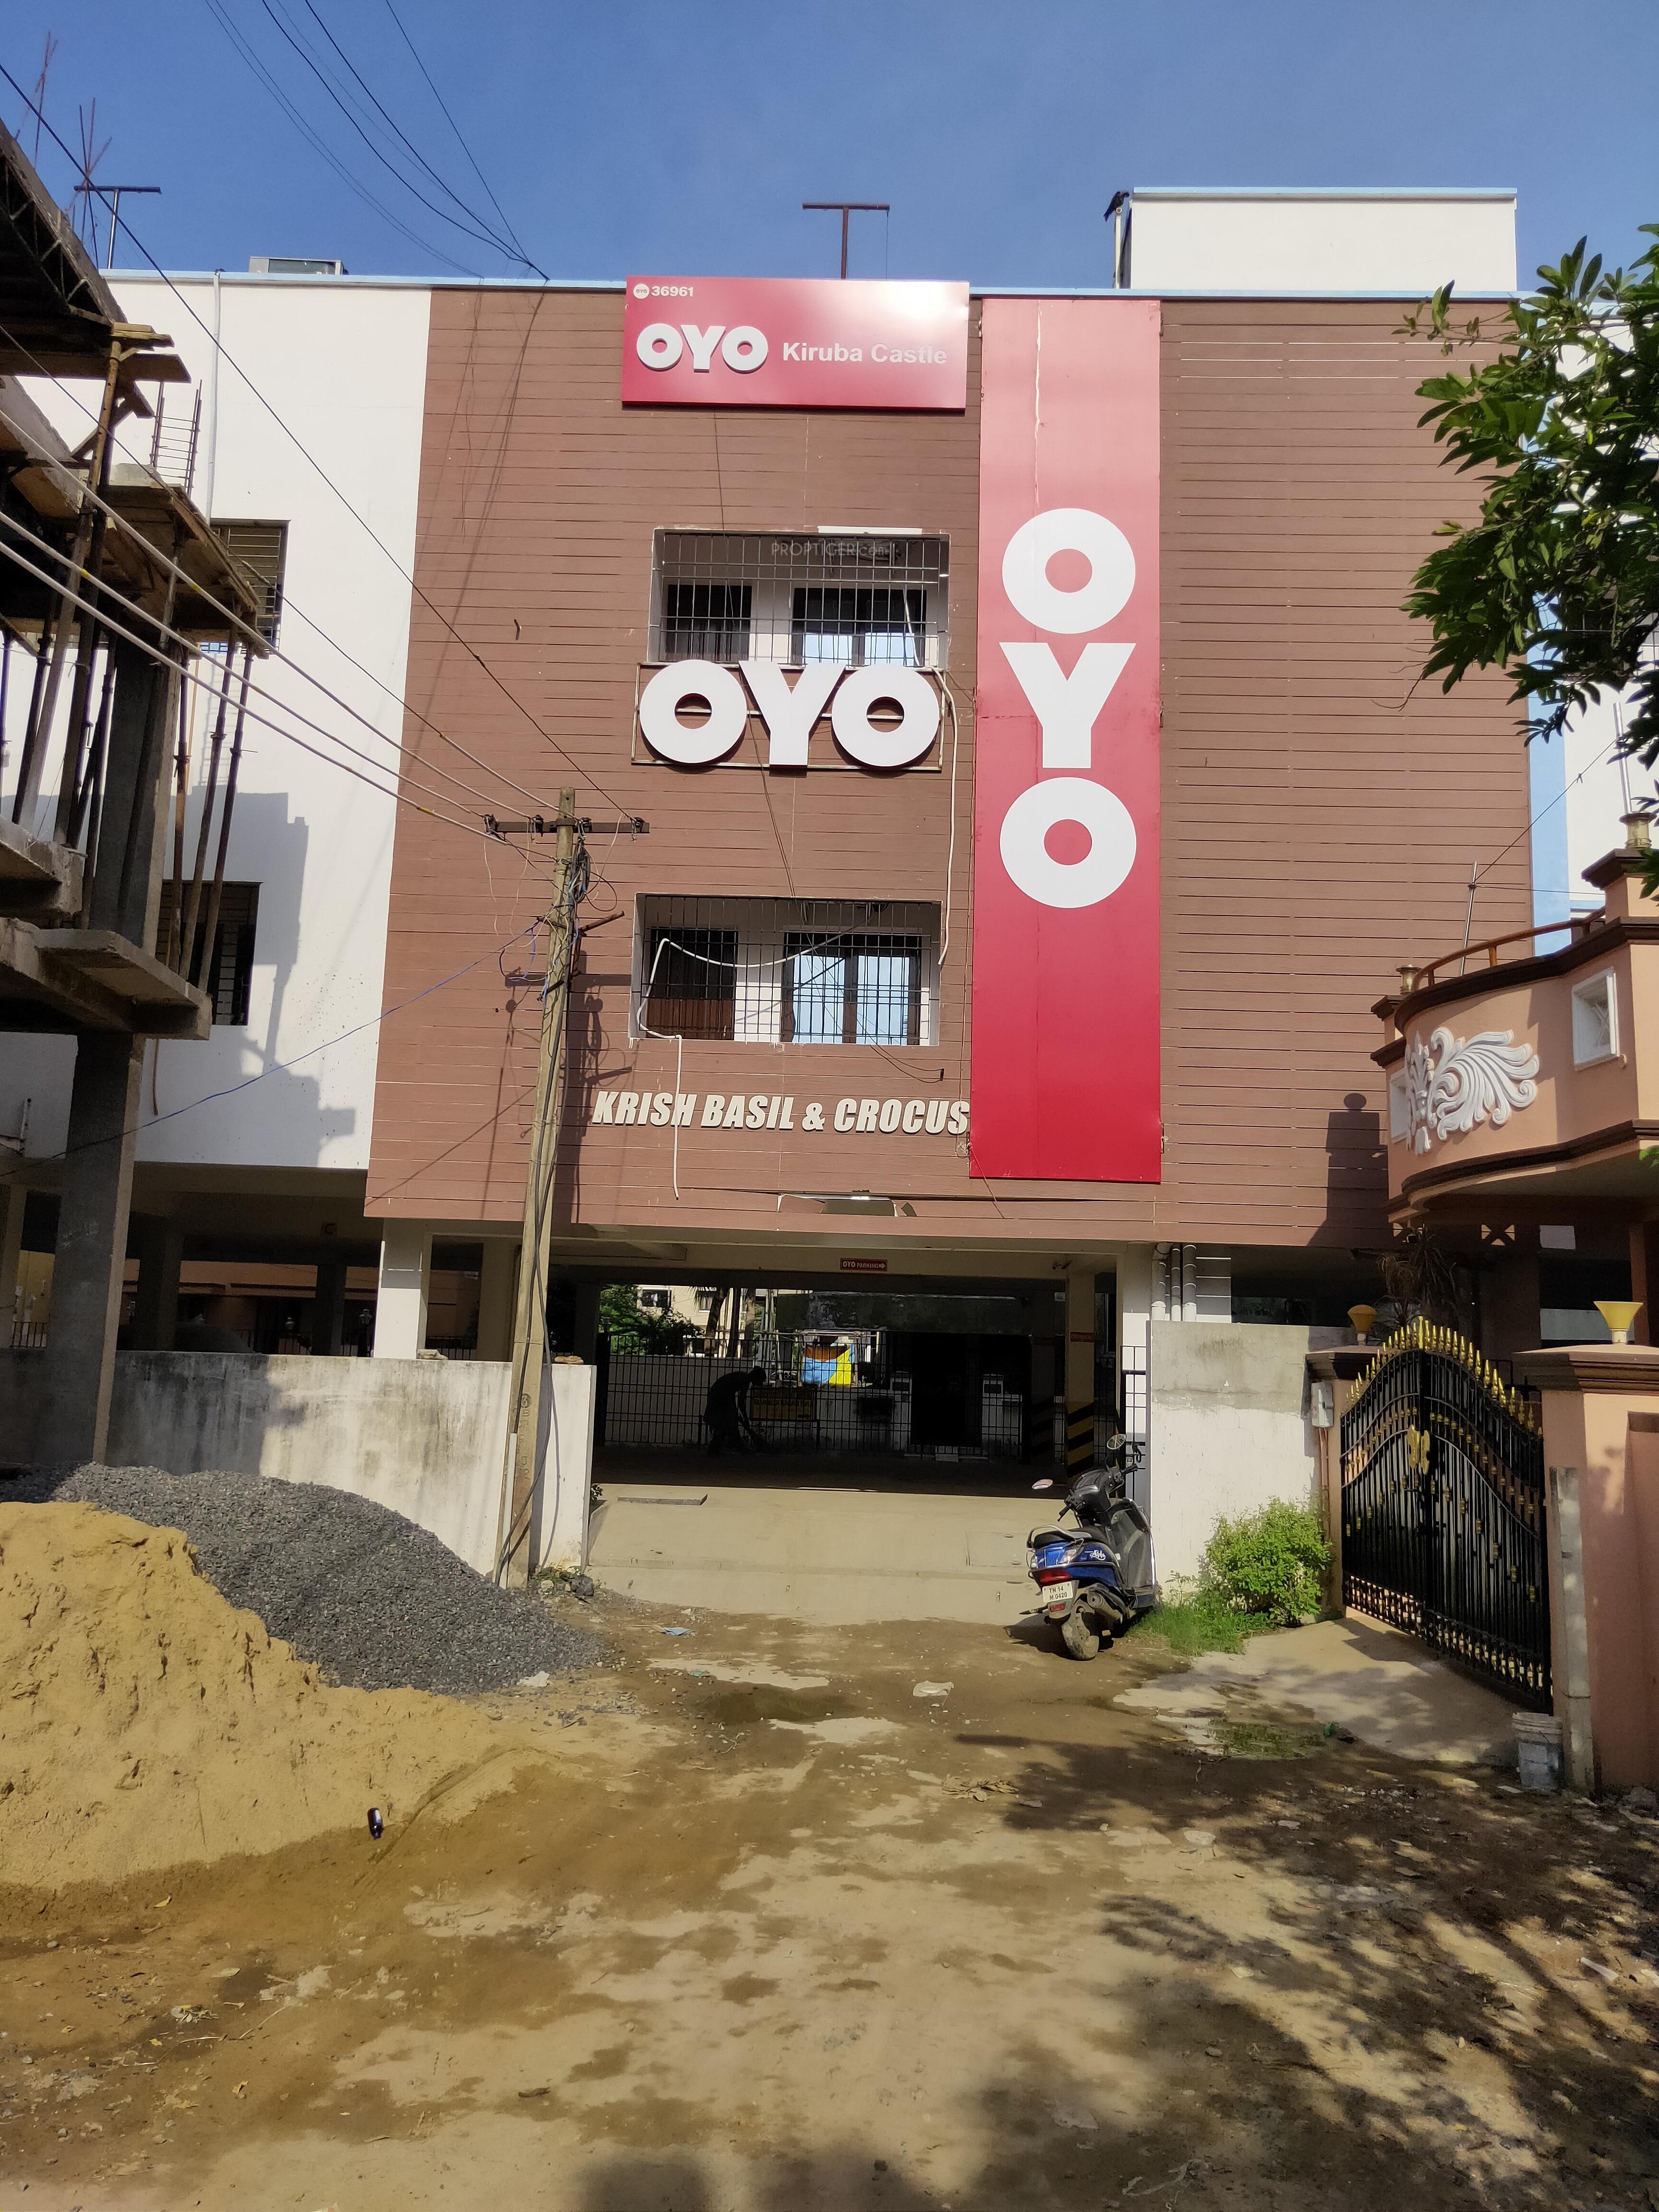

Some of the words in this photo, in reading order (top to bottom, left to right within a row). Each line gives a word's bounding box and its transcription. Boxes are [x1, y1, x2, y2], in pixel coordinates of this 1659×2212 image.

[651, 285, 694, 297] 36961
[636, 323, 769, 373] OYO
[782, 342, 863, 362] Kiruba
[871, 343, 948, 364] Castle
[639, 659, 939, 767] OYO
[1000, 508, 1137, 908] OYO
[592, 1091, 697, 1127] KRISH
[700, 1094, 794, 1130] BASIL
[802, 1102, 826, 1131] &
[834, 1097, 970, 1134] CROCUS
